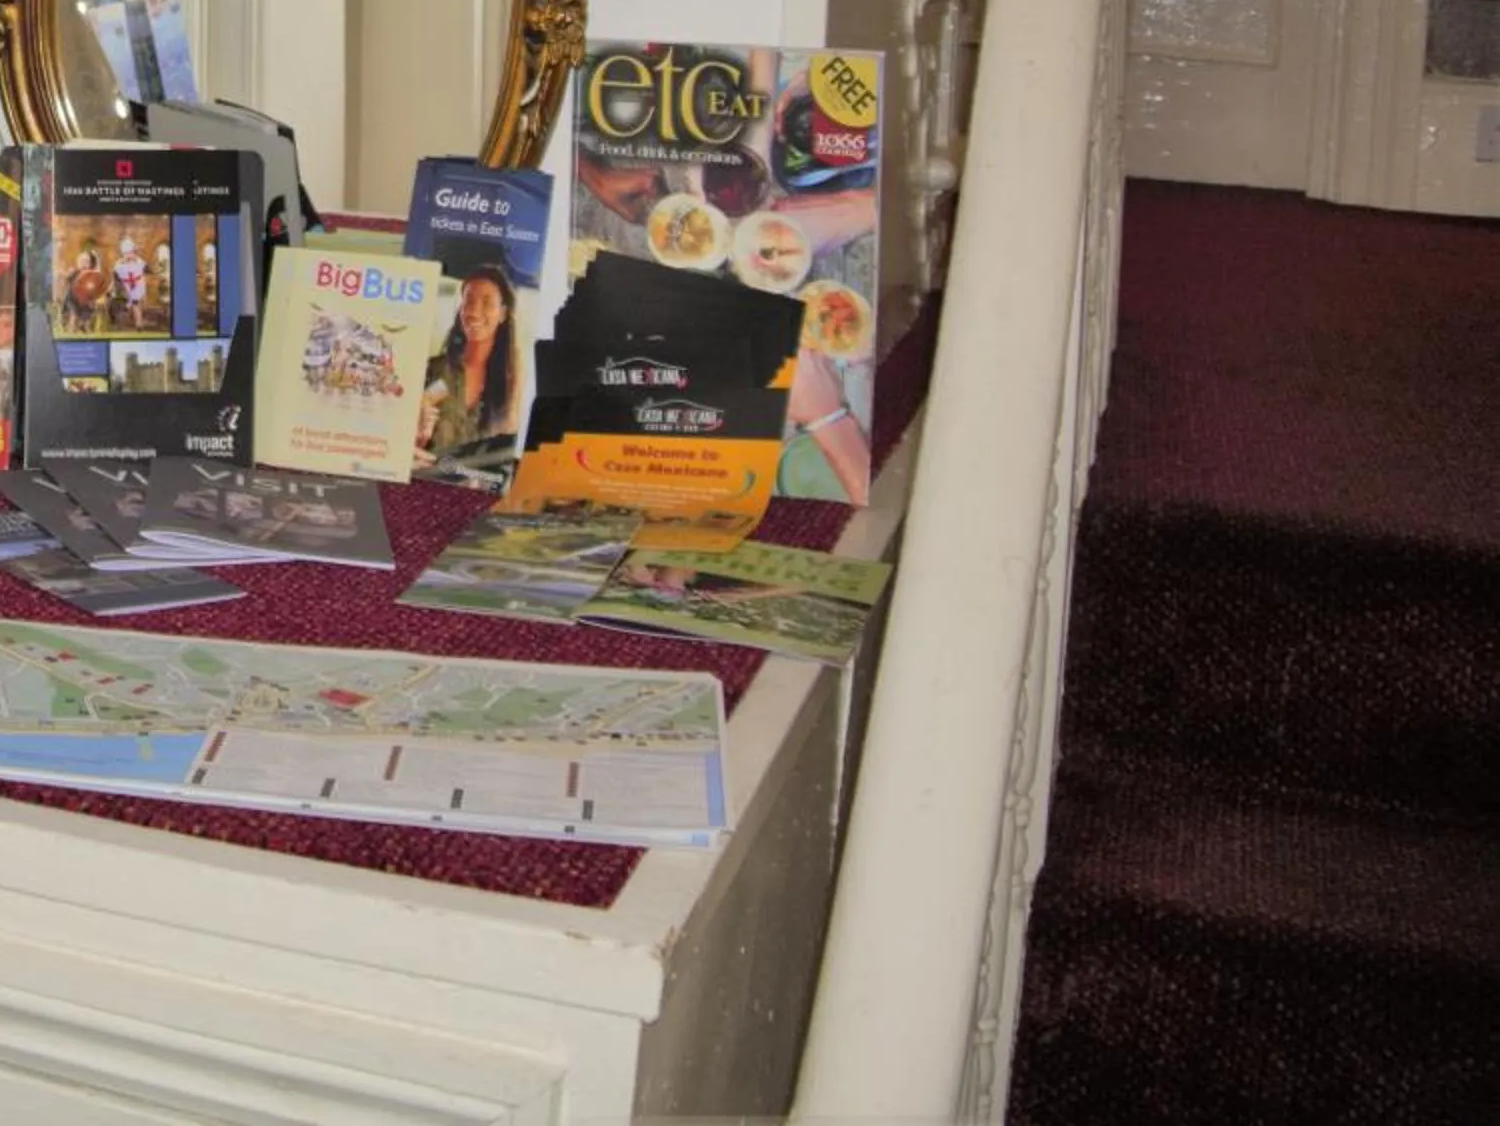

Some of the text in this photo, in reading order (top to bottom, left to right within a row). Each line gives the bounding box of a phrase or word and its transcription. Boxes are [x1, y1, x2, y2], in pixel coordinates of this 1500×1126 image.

[589, 46, 743, 145] etc
[821, 57, 877, 117] FREE
[708, 91, 765, 119] EAT
[815, 132, 867, 149] 1066
[85, 186, 121, 196] BATTLE
[123, 186, 136, 196] OF
[138, 186, 185, 197] HASTINGS
[435, 187, 511, 216] Guide to
[185, 433, 235, 453] impact
